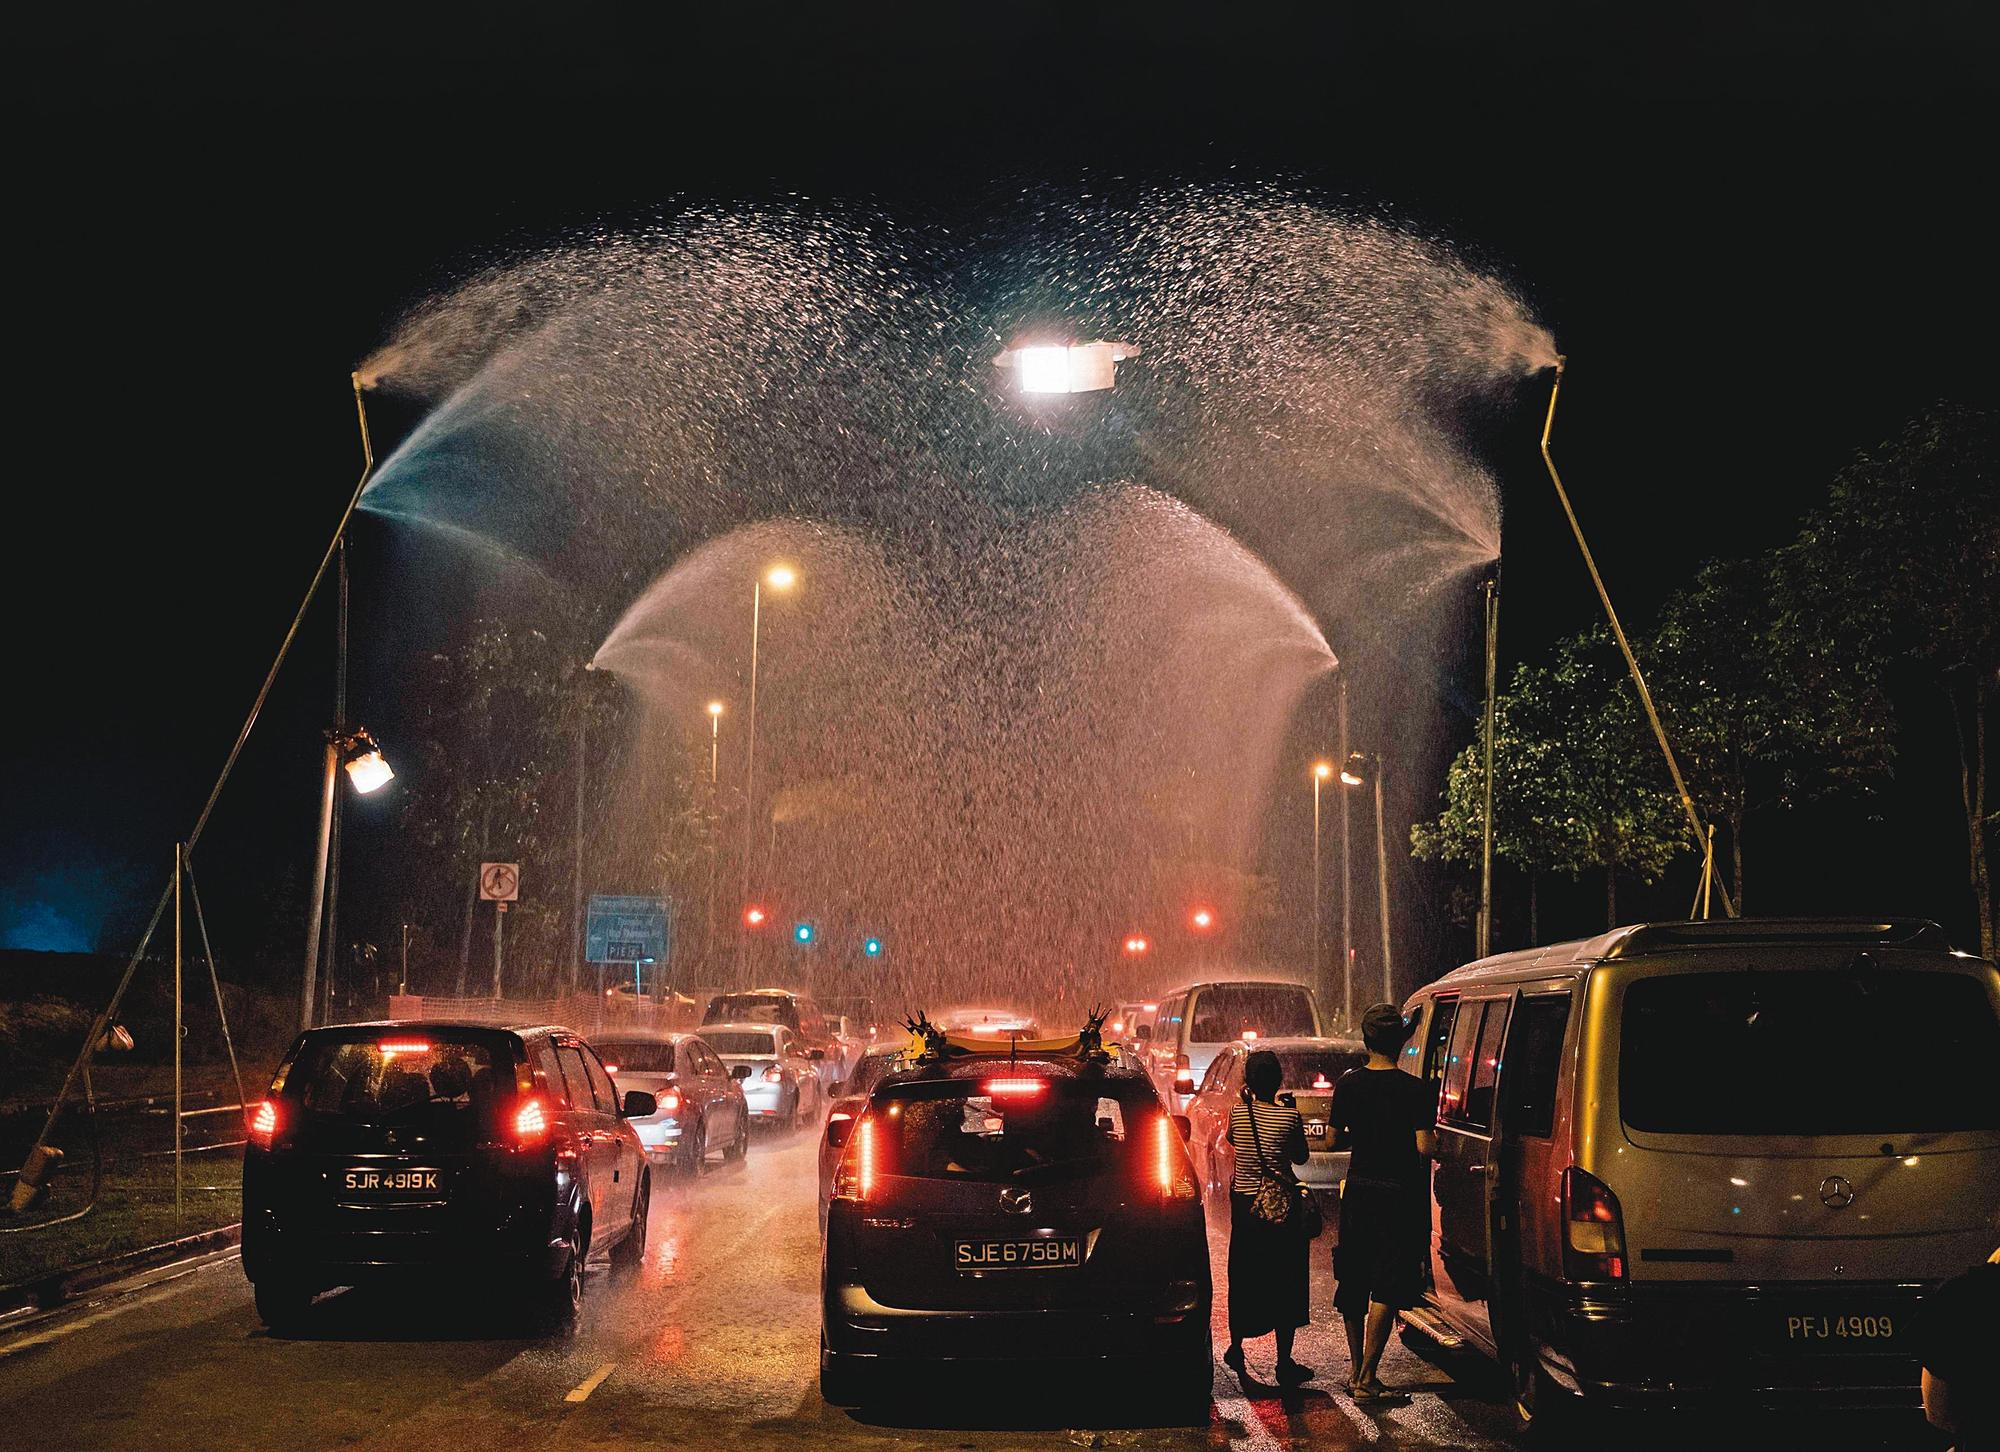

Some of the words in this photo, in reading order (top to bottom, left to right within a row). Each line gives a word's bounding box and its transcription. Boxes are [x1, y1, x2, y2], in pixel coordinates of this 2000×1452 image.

[1303, 1124, 1323, 1136] SKD
[345, 1173, 379, 1189] SJR
[383, 1173, 422, 1189] 4919
[958, 1244, 1000, 1263] SJE
[1003, 1242, 1059, 1262] 6758
[1787, 1316, 1829, 1339] PFJ
[1835, 1316, 1893, 1338] 4909
